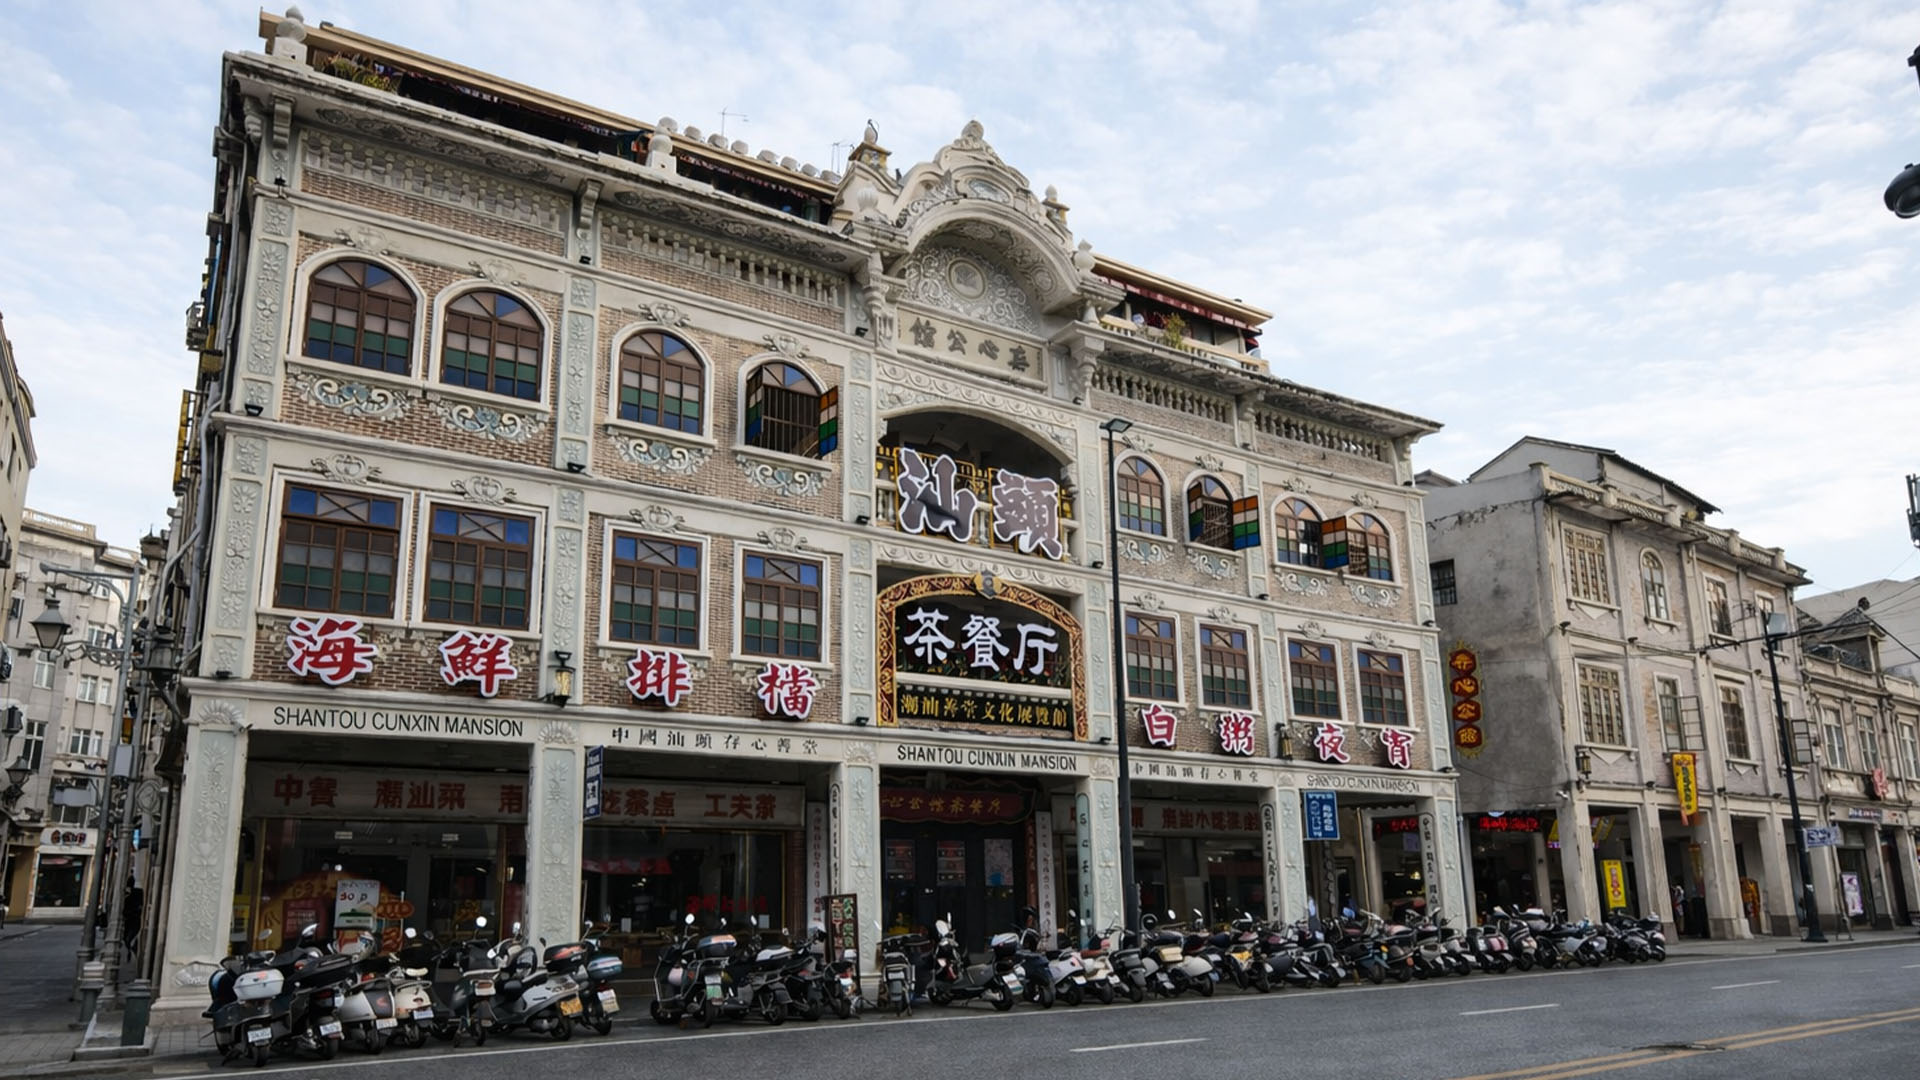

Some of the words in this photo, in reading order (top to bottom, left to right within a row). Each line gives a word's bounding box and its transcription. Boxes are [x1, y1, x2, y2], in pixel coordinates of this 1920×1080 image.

[897, 447, 1063, 561] 汕頭
[903, 607, 1059, 676] 茶餐厅
[273, 706, 367, 730] SHANTOU
[372, 711, 440, 732] CUNXIN
[445, 716, 523, 737] MANSION
[897, 744, 963, 765] SHANTOU
[967, 750, 1016, 767] CUNXIN
[1020, 754, 1077, 771] MANSION
